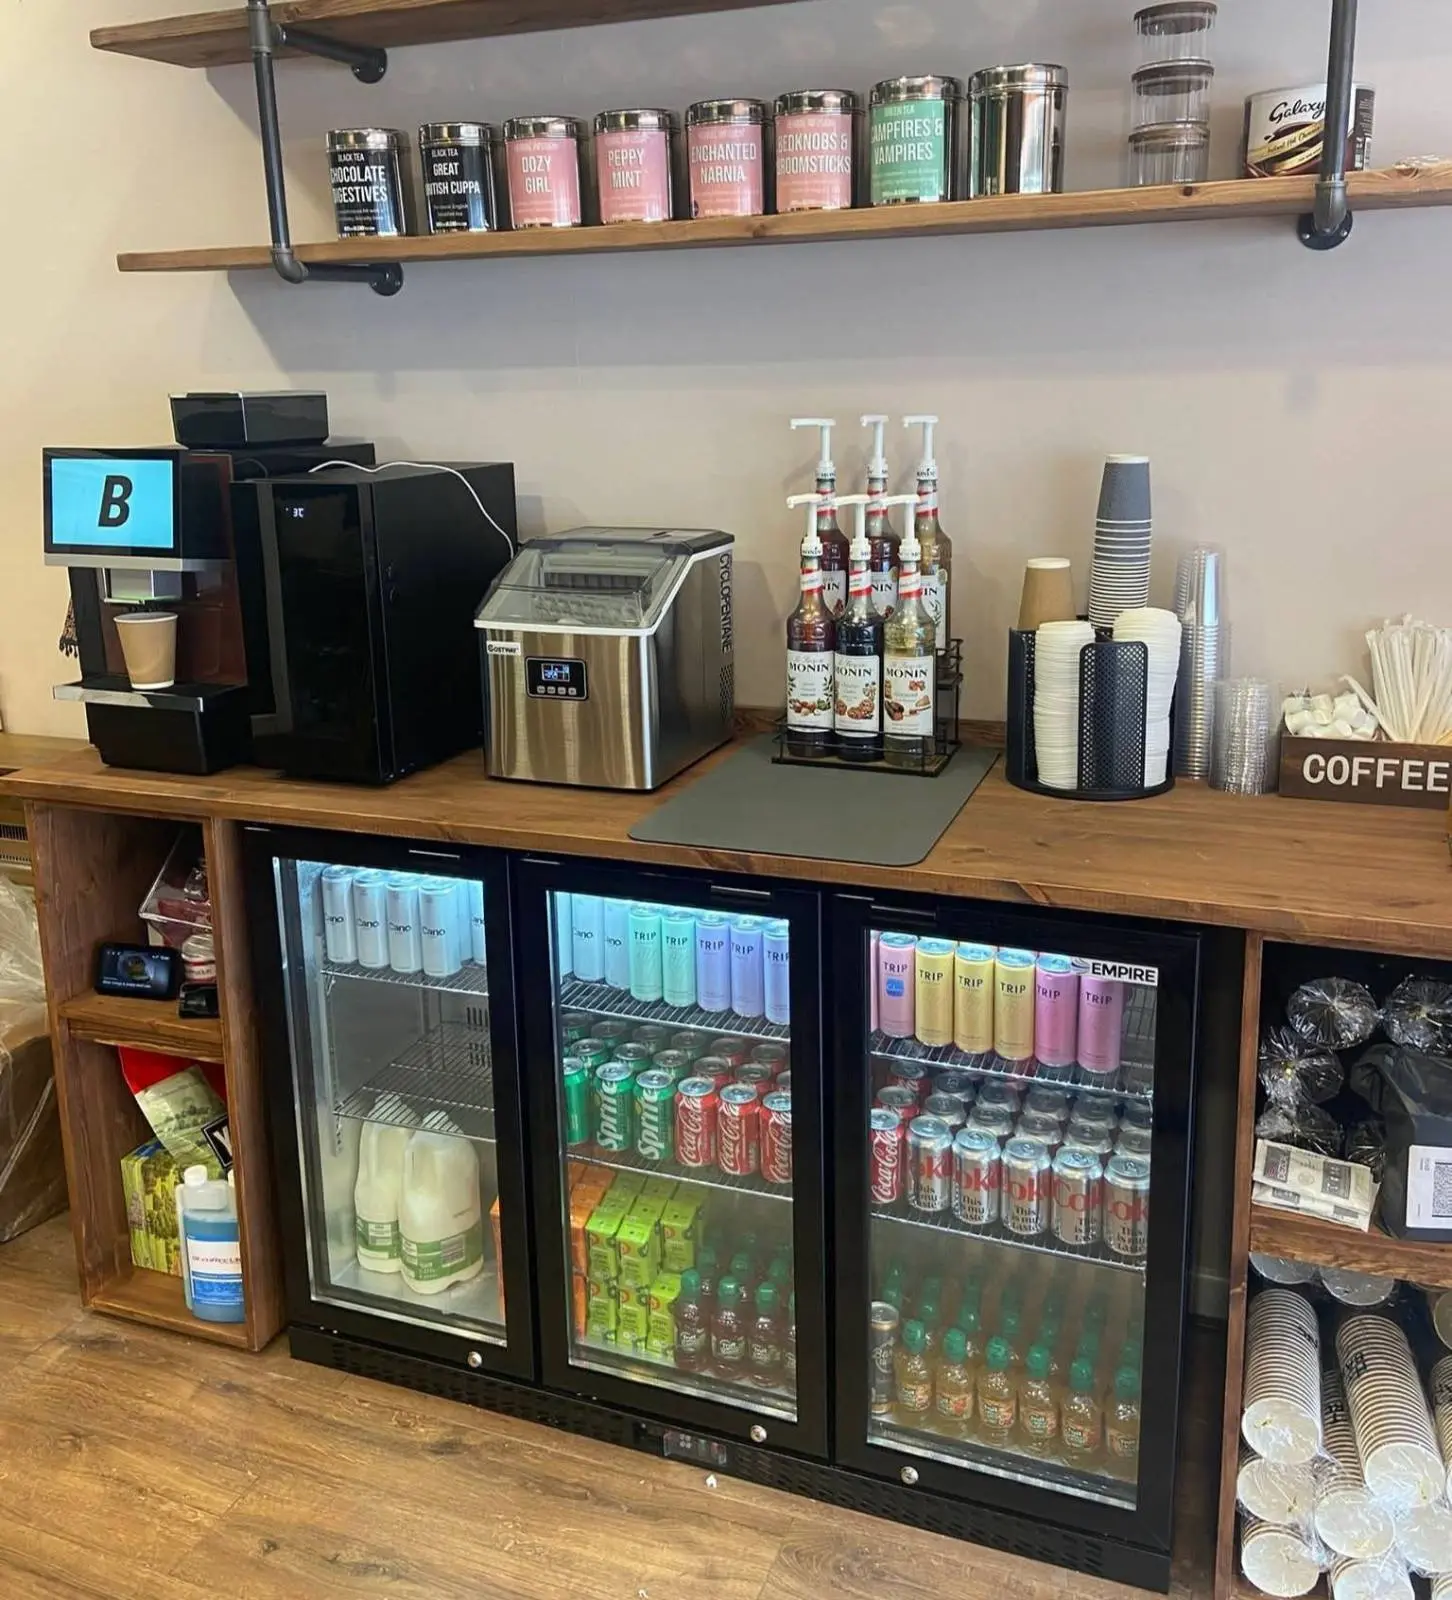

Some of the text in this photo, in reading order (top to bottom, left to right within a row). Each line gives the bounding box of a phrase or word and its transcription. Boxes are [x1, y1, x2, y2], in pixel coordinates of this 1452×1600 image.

[1269, 99, 1325, 124] Galaxy
[934, 118, 944, 136] &
[840, 133, 848, 149] &
[353, 153, 365, 162] TEA
[447, 148, 459, 157] TEA
[608, 148, 645, 167] PEPPY
[691, 143, 757, 163] ENCHANTED
[874, 142, 933, 165] VAMPIRES
[433, 162, 459, 176] GREAT
[521, 155, 551, 173] DOZY
[330, 165, 386, 184] CHOCOLATE
[612, 170, 642, 188] MINT
[700, 165, 746, 185] NARNIA
[450, 180, 481, 194] CUPPA
[525, 176, 552, 194] GIRL
[98, 474, 133, 528] B
[822, 582, 840, 592] NIN
[871, 583, 893, 592] NIN
[719, 553, 734, 654] CYCLOPENTANE
[789, 662, 829, 673] MONIN
[886, 667, 928, 679] MONIN
[1302, 753, 1450, 793] COFFEE
[356, 918, 380, 928] Cano
[389, 922, 412, 932] Cano
[422, 926, 446, 936] Cano
[634, 931, 657, 941] TRIP
[666, 935, 689, 946] TRIP
[699, 939, 724, 950] TRIP
[731, 943, 754, 955] TRIP
[884, 961, 908, 973] TRIP
[1091, 962, 1156, 983] EMPIRE
[919, 969, 944, 981] TRIP
[958, 975, 984, 987] TRIP
[1000, 982, 1027, 994] TRIP
[1037, 984, 1061, 999] TRIP
[1086, 991, 1113, 1005] TRIP
[597, 1081, 623, 1151] Sprite
[637, 1087, 665, 1161] Sprite
[678, 1095, 703, 1167] Coca-Cola
[719, 1102, 742, 1175] Coca-Cola
[871, 1130, 898, 1204] Coca-Cola
